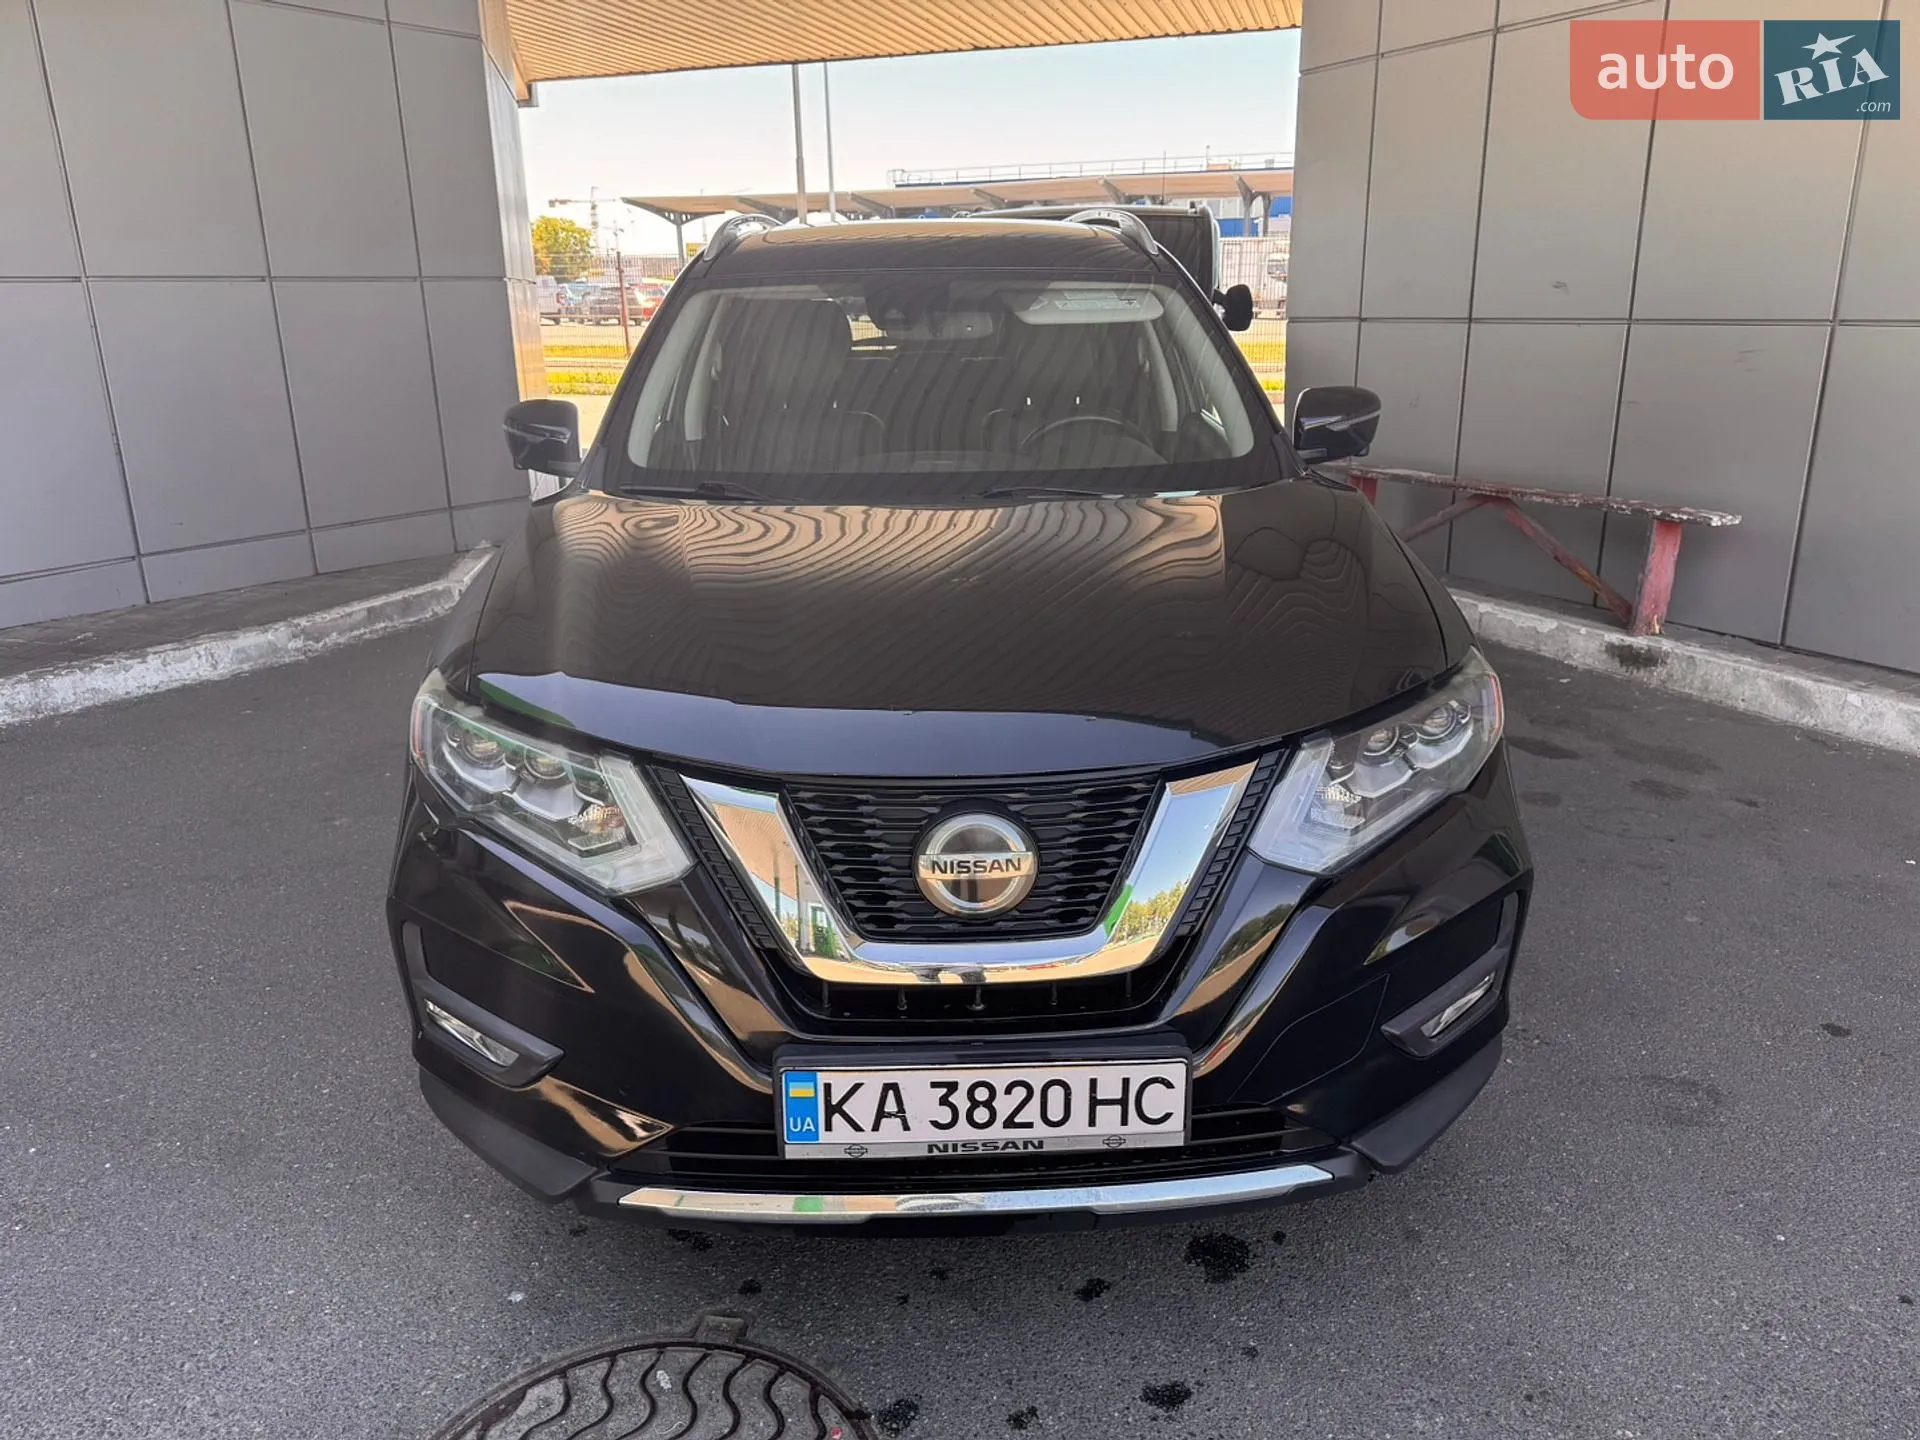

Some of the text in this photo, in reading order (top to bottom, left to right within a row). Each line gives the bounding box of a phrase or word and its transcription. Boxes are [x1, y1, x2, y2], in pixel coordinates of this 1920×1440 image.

[931, 857, 1022, 875] NISSAN
[823, 1075, 1176, 1133] KA 3820 HC
[789, 1117, 816, 1133] UA
[927, 1138, 1044, 1154] NISSAN
